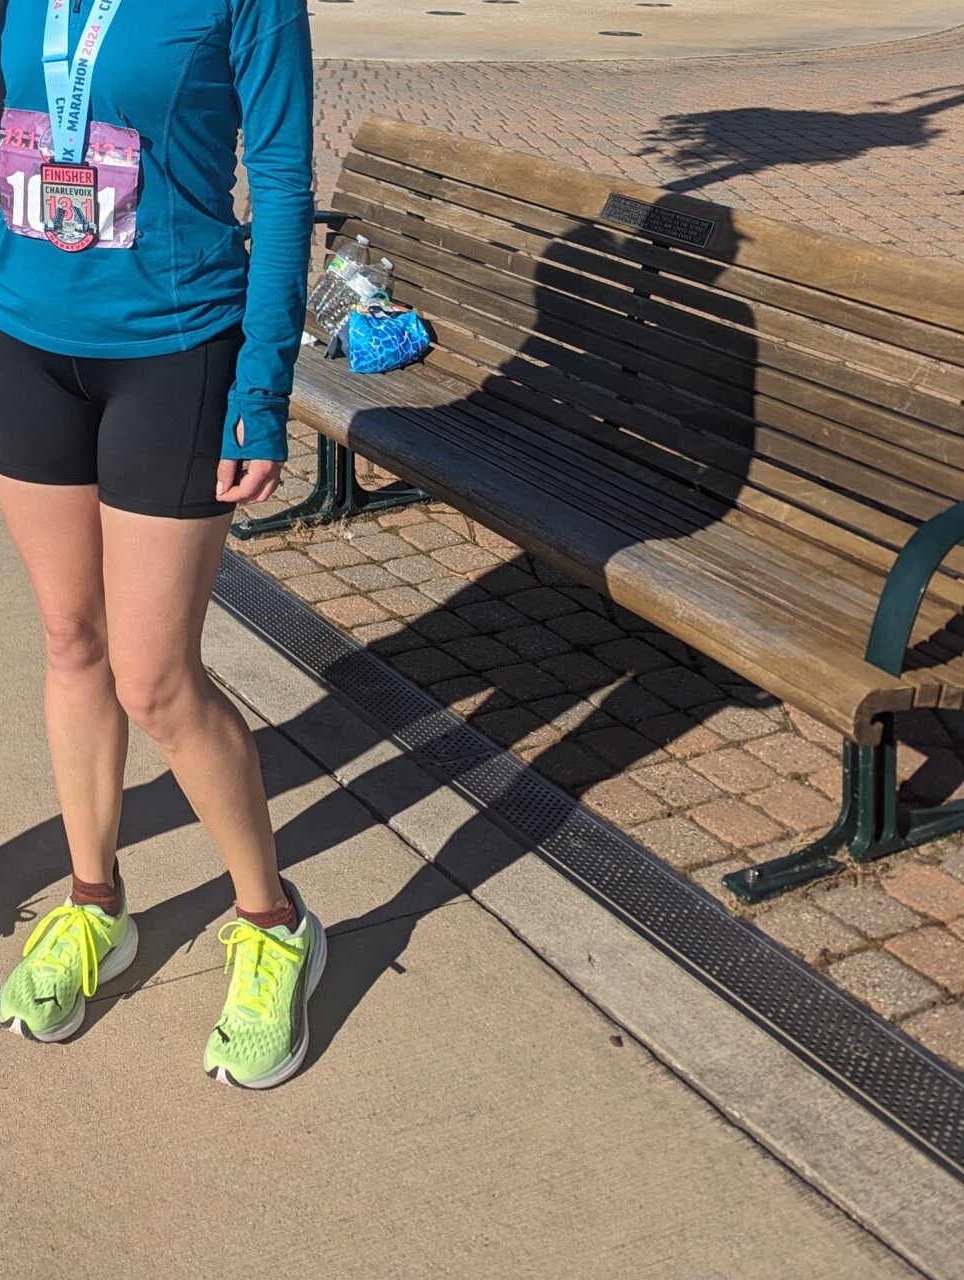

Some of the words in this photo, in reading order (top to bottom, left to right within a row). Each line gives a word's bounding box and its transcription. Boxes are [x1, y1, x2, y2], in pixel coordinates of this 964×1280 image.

[67, 58, 89, 133] MARATHON
[82, 24, 102, 57] 2024
[4, 126, 37, 151] 13.1
[44, 169, 93, 184] FINISHER
[44, 185, 93, 197] CHARLEVOIX
[48, 233, 92, 252] MARATHON
